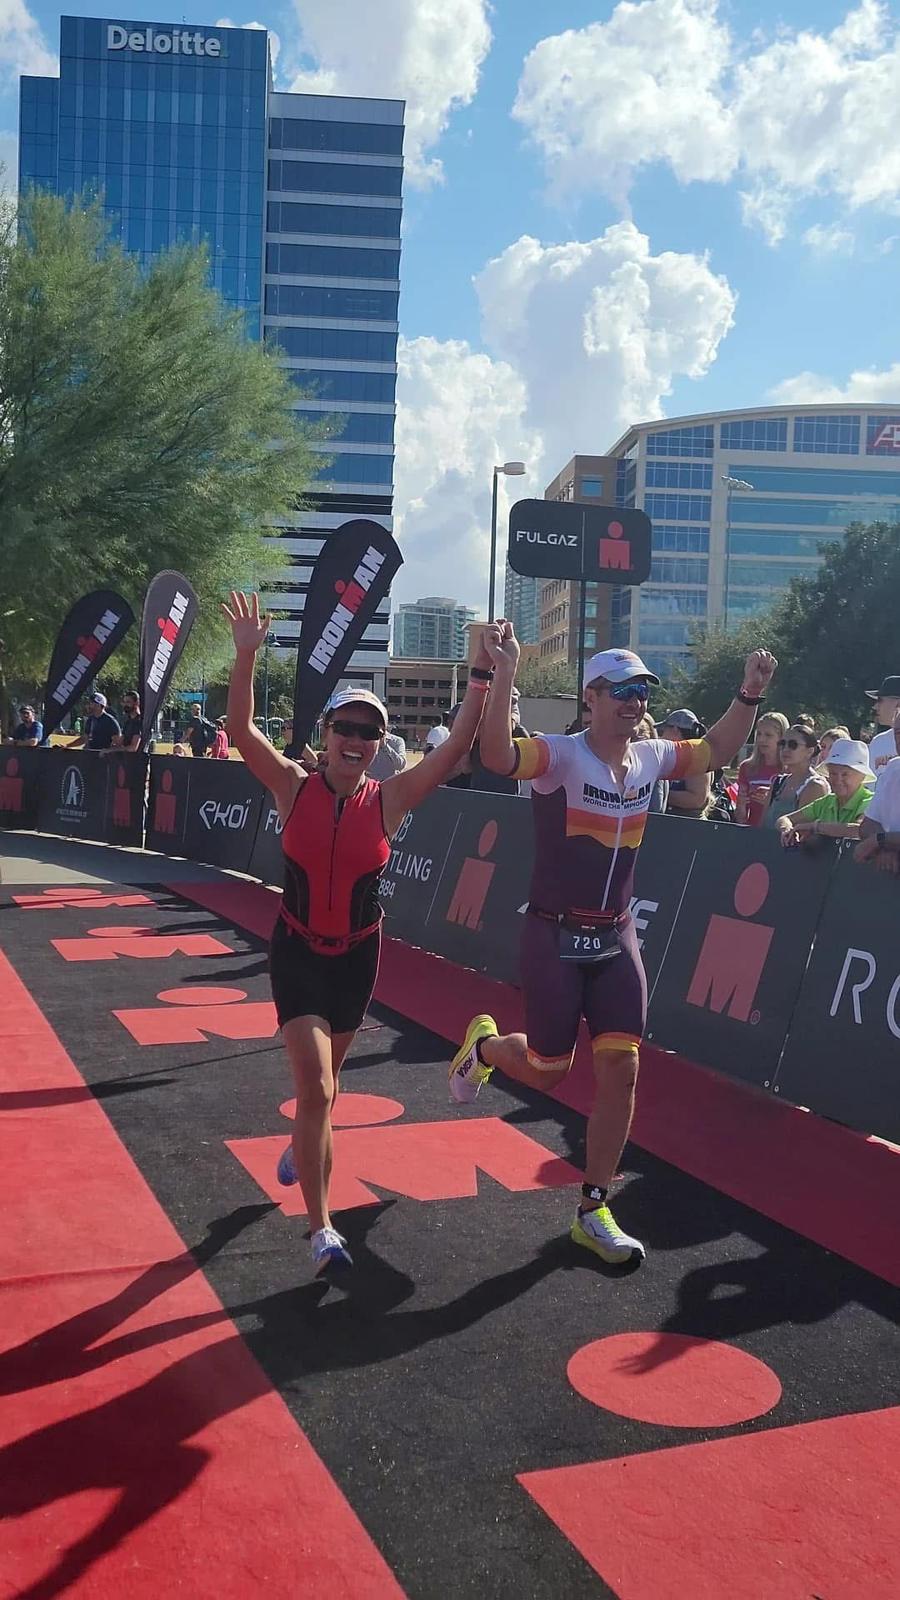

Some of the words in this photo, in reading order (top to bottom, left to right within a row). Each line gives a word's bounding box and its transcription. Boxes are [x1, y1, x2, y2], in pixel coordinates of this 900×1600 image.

[107, 24, 221, 57] Deloitte
[516, 530, 578, 547] FULGAZ
[307, 545, 386, 675] IRONMAN
[52, 609, 121, 706] IRONMAN
[147, 591, 190, 693] IRONMAN
[388, 849, 433, 882] TLING
[377, 878, 396, 898] 884
[572, 935, 601, 950] 720
